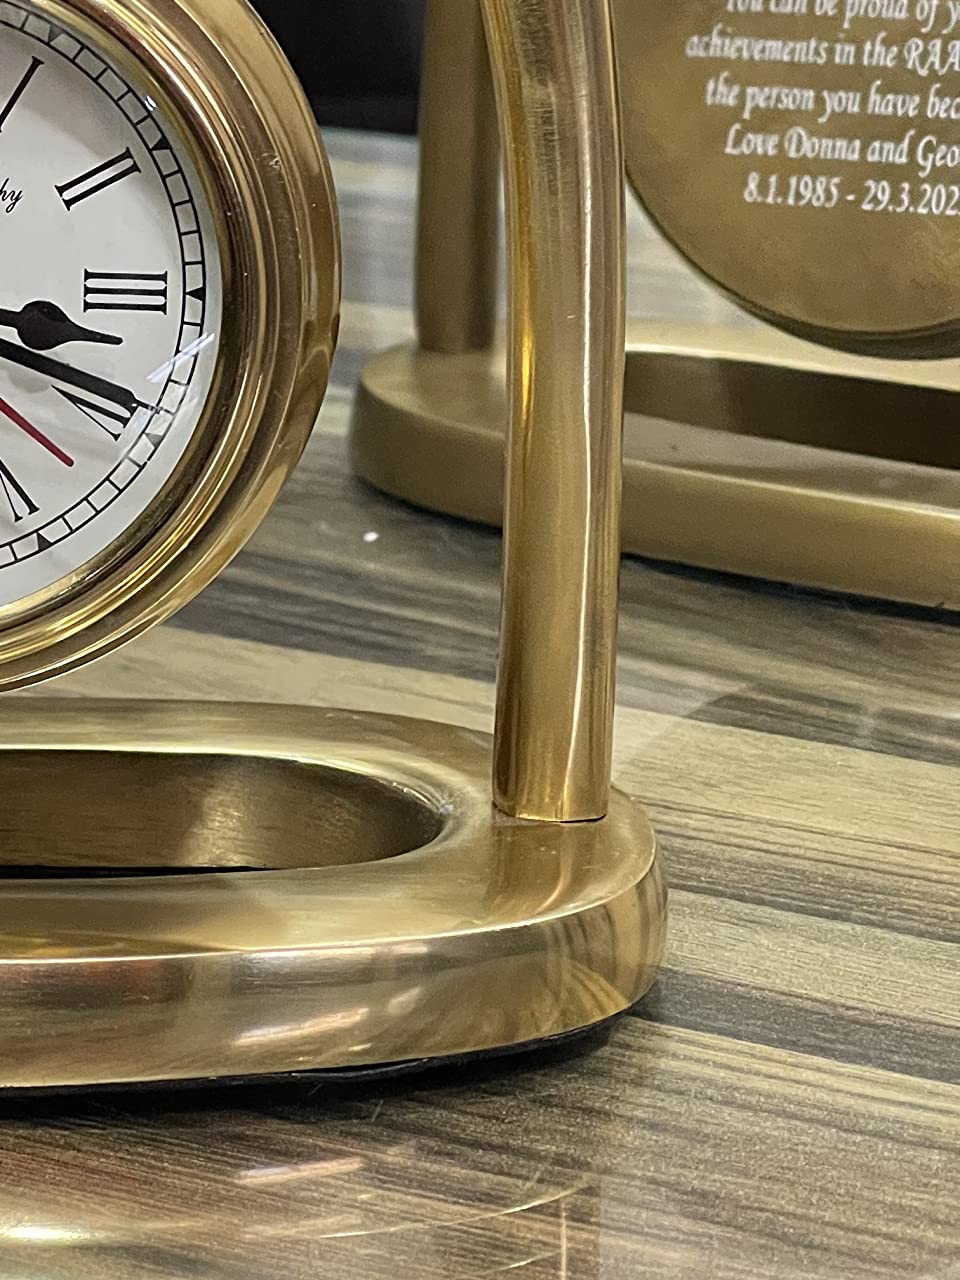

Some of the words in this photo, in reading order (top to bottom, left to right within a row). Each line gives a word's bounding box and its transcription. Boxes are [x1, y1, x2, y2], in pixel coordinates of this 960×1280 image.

[685, 22, 829, 65] achievements
[834, 33, 856, 65] in
[863, 31, 897, 68] the
[705, 71, 740, 107] the
[743, 84, 815, 120] person
[818, 89, 860, 123] you
[867, 80, 920, 118] have
[724, 123, 779, 156] Love
[784, 126, 860, 161] Donna
[867, 129, 915, 165] and
[55, 147, 141, 211] II
[744, 171, 841, 208] 8.1.1985
[861, 180, 960, 215] 29.3.202
[84, 269, 167, 315] III
